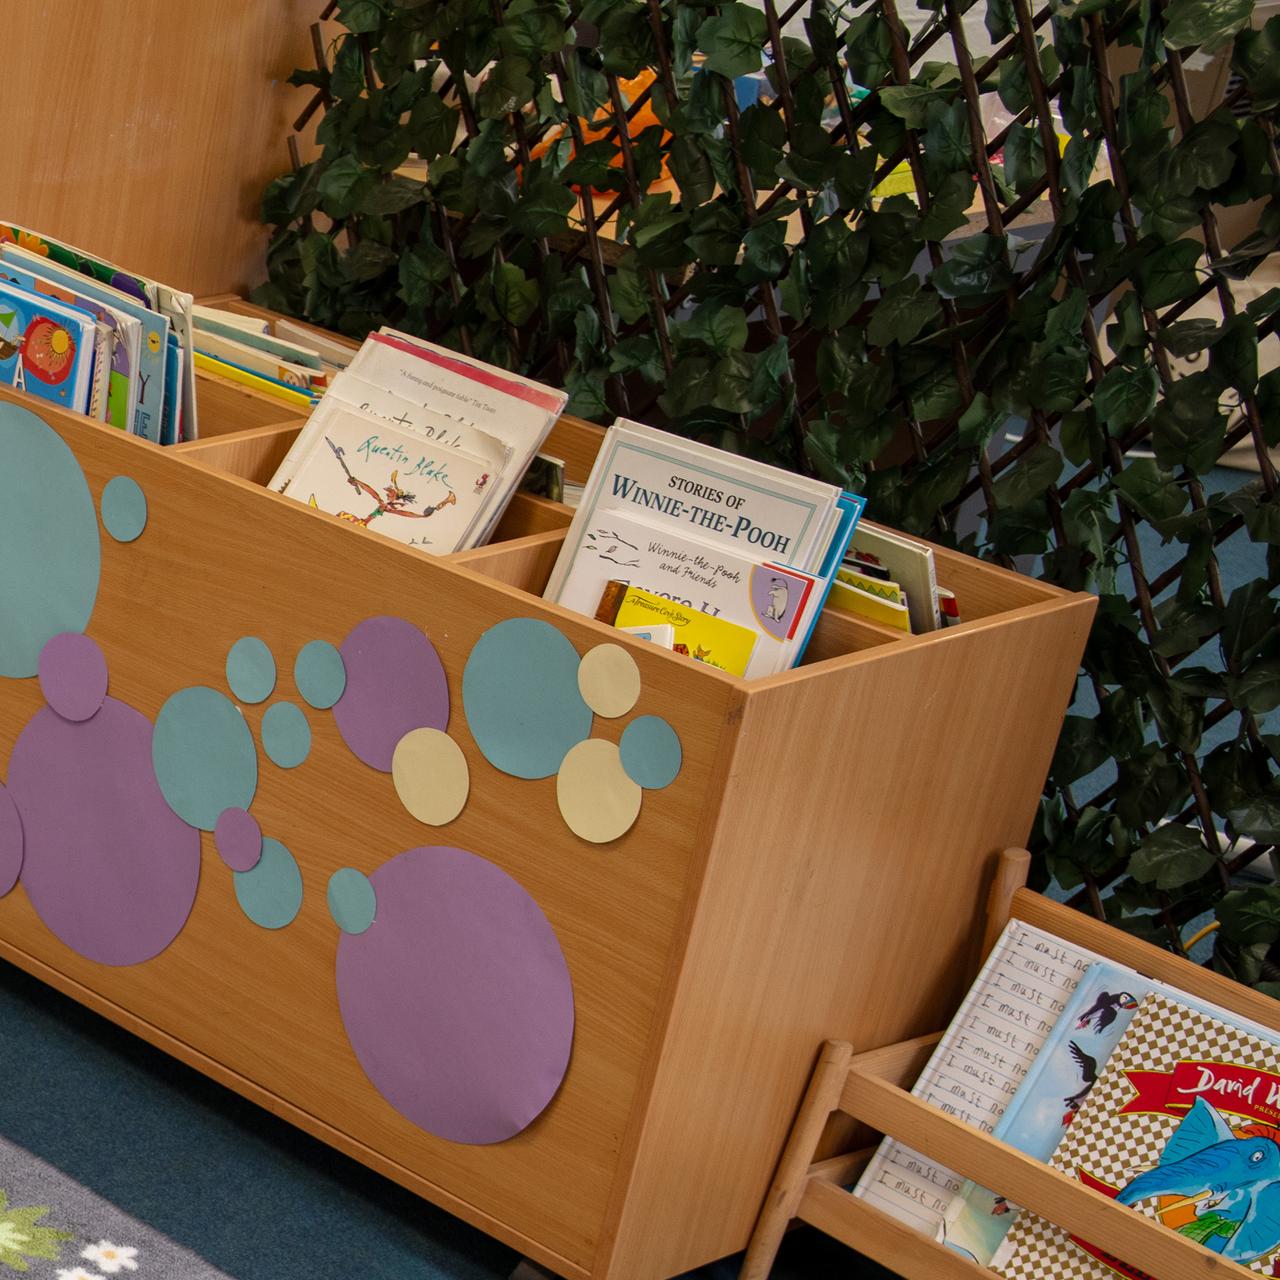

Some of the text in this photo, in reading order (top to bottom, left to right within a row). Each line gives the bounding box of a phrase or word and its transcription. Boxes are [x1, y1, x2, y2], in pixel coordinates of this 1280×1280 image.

[357, 435, 454, 489] Quentin Blake
[668, 475, 746, 511] STORIES OF
[612, 474, 791, 555] WINNIE-THE-POOH
[648, 541, 741, 585] Winnie-the-Pooh
[659, 561, 718, 589] and Friends
[1015, 933, 1028, 947] I
[1035, 942, 1067, 964] must
[1006, 951, 1017, 966] I
[1024, 959, 1057, 983] must
[992, 973, 1004, 987] I
[1010, 981, 1044, 1004] must
[982, 994, 994, 1008] I
[998, 1002, 1032, 1026] must
[968, 1015, 980, 1030] I
[987, 1025, 1017, 1049] must
[956, 1036, 968, 1050] I
[974, 1047, 1007, 1068] must
[946, 1054, 957, 1067] I
[963, 1064, 996, 1086] must
[1177, 1065, 1262, 1105] David
[933, 1075, 945, 1088] I
[950, 1085, 982, 1108] must
[941, 1103, 972, 1123] must
[890, 1150, 901, 1165] I
[906, 1160, 938, 1184] must
[878, 1170, 890, 1185] I
[895, 1181, 926, 1204] must
